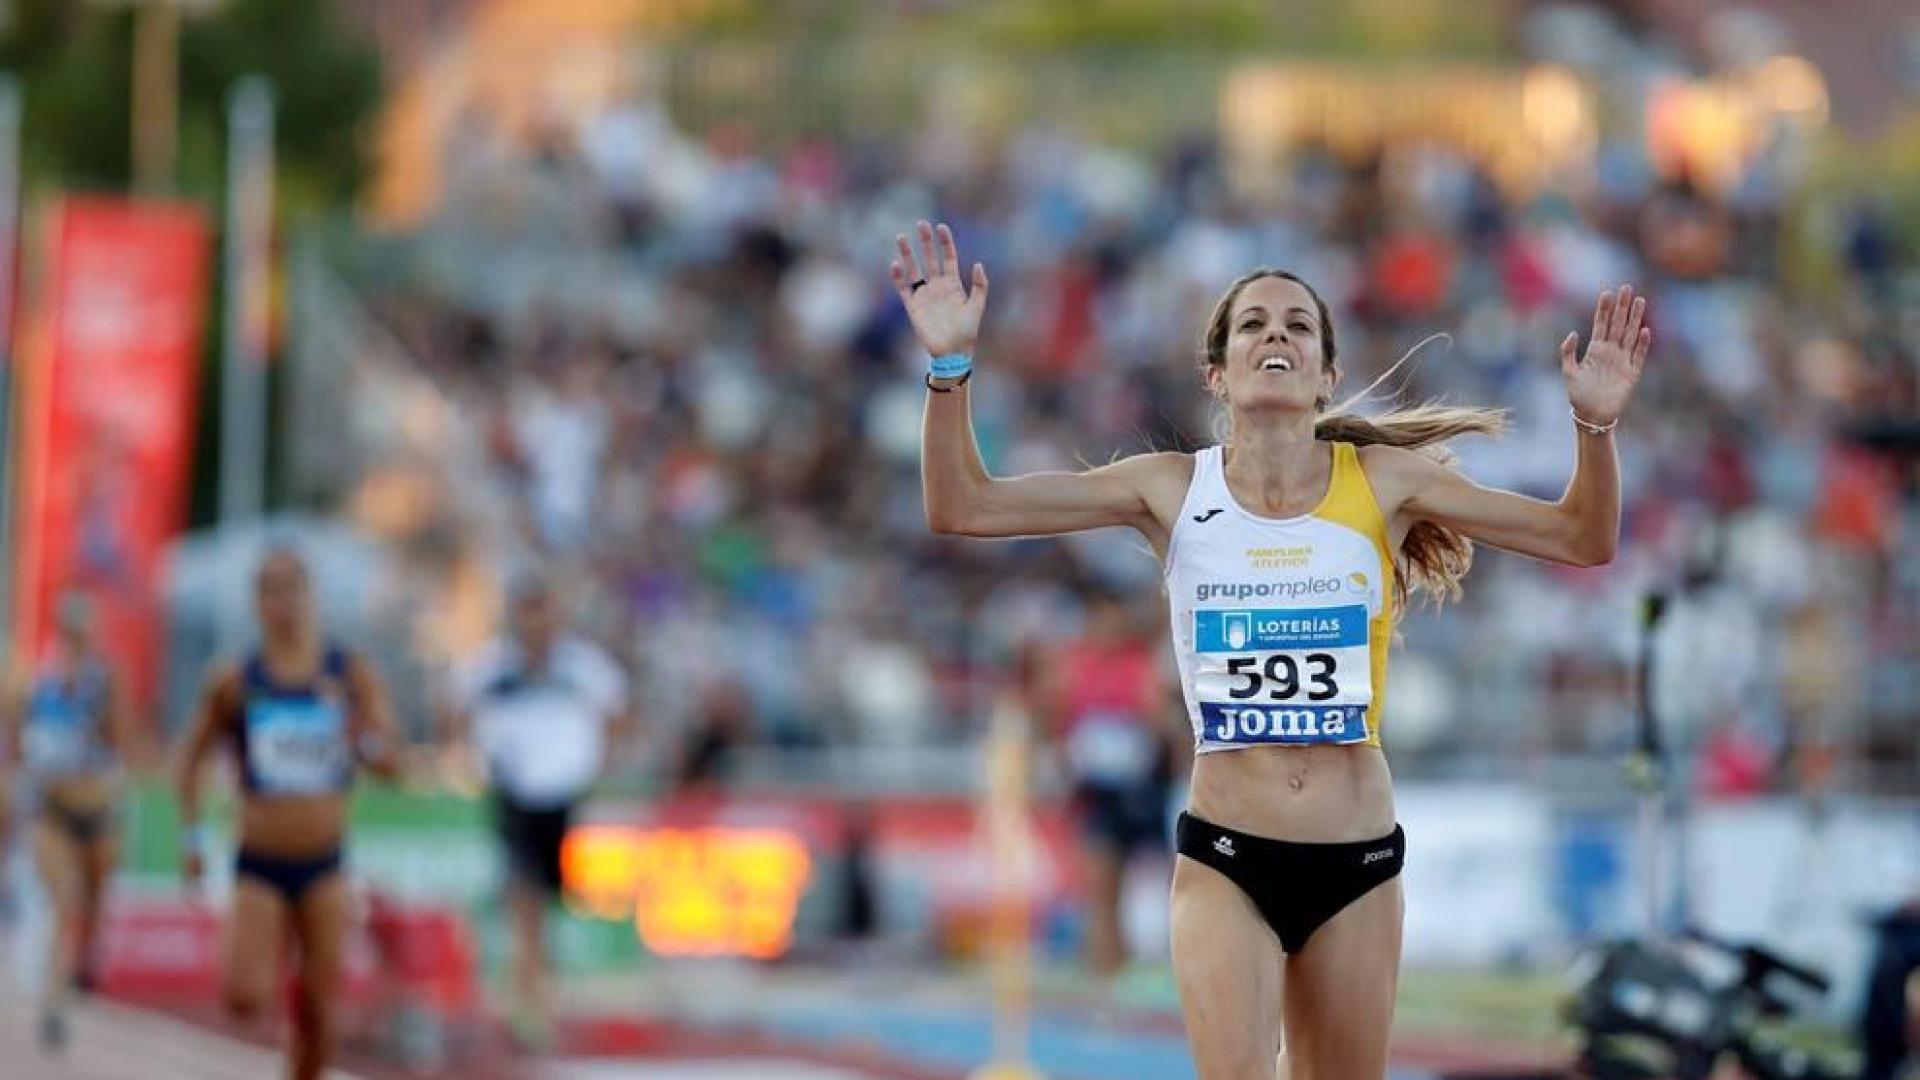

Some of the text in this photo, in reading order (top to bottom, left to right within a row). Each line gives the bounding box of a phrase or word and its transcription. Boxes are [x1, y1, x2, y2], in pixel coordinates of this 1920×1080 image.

[1196, 576, 1341, 601] grupompleo
[1258, 616, 1341, 633] LOTERÍAS
[1226, 653, 1339, 700] 593
